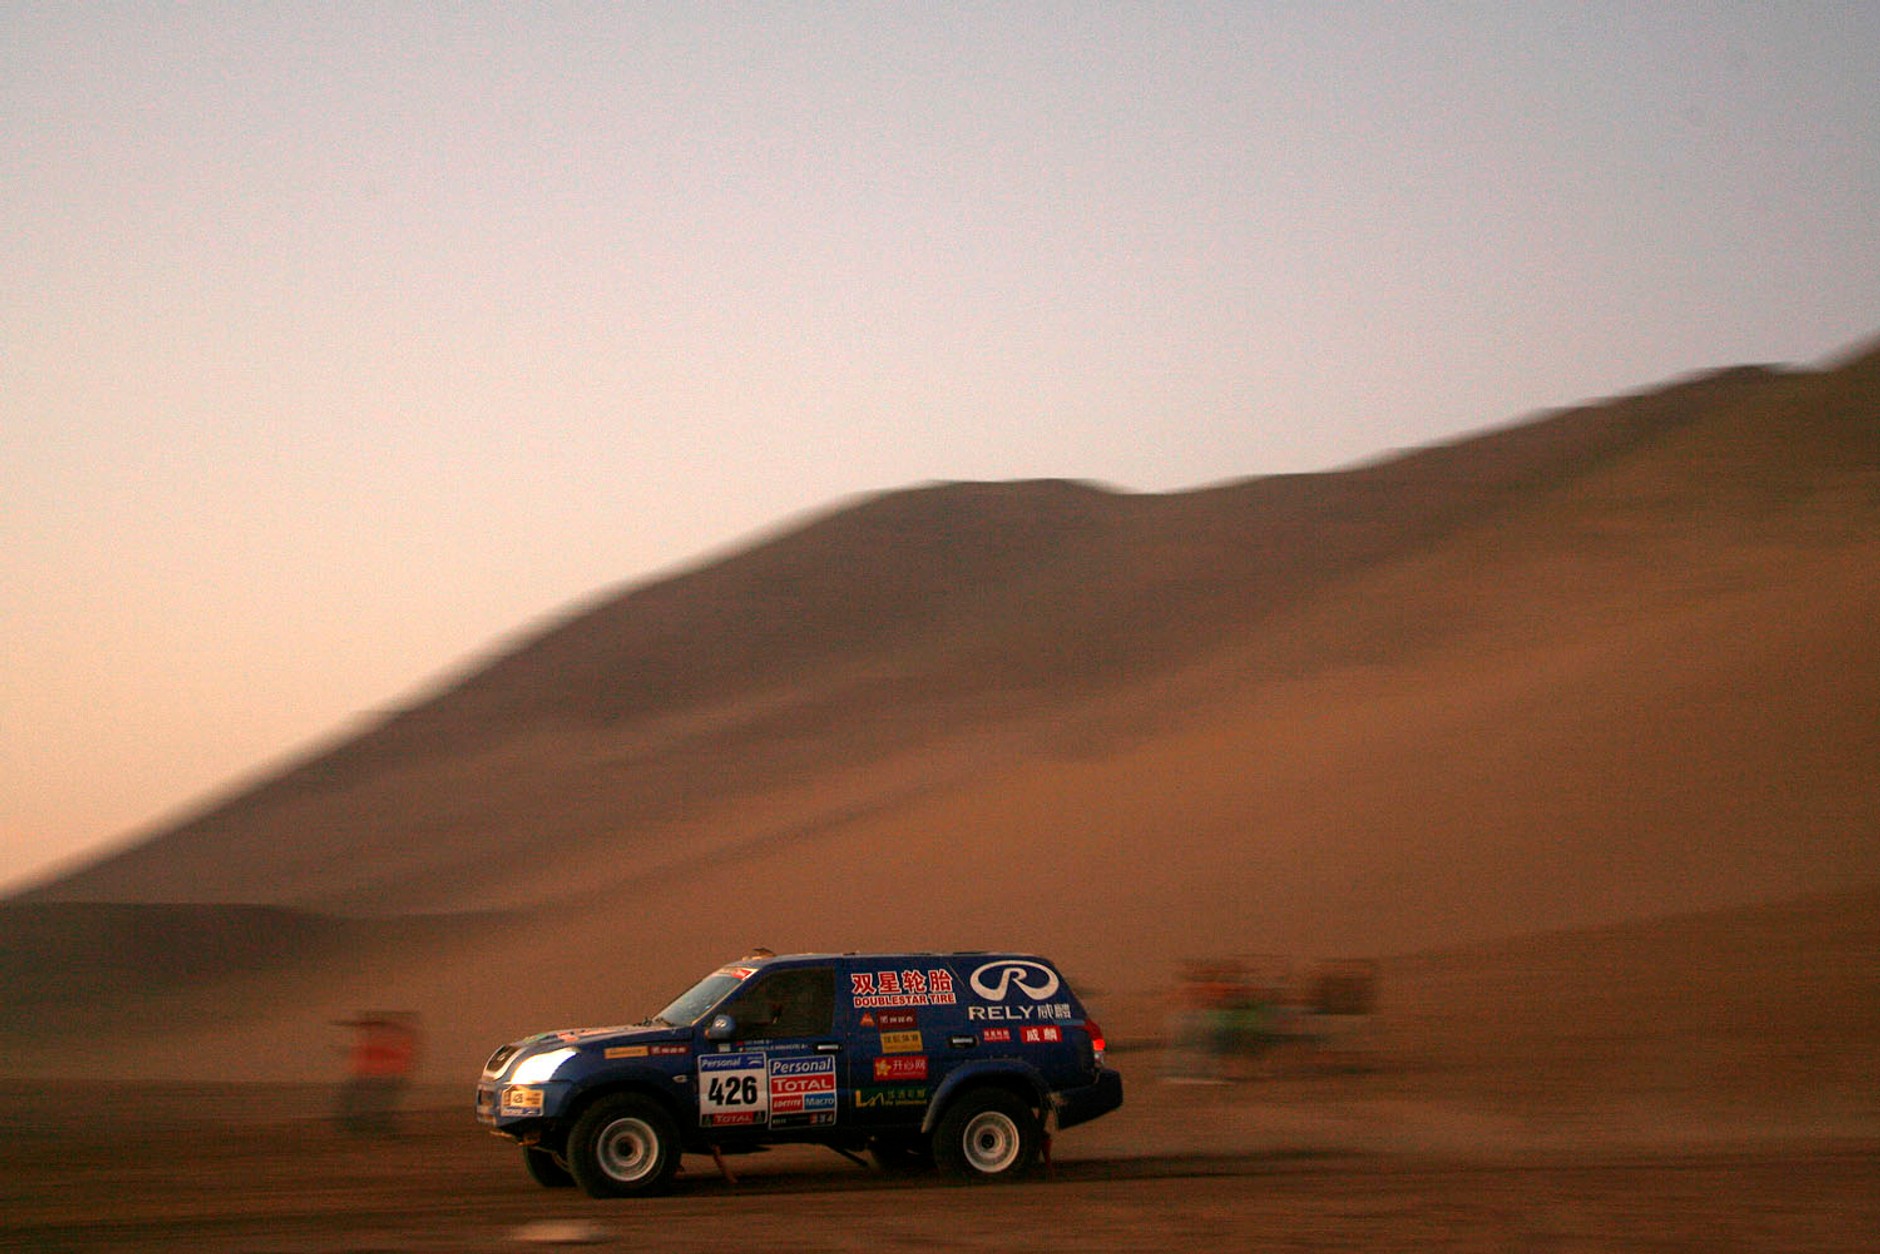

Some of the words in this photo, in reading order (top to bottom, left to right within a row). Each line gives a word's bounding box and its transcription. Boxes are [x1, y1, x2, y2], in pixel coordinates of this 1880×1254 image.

[851, 969, 952, 994] 双星轮胎
[854, 995, 927, 1007] DOUBLESTAR
[928, 993, 956, 1004] TIRE
[968, 1005, 1034, 1020] RELY
[701, 1058, 740, 1068] Personal
[772, 1058, 831, 1074] Personal
[708, 1076, 758, 1106] 426
[773, 1079, 832, 1091] TOTAL
